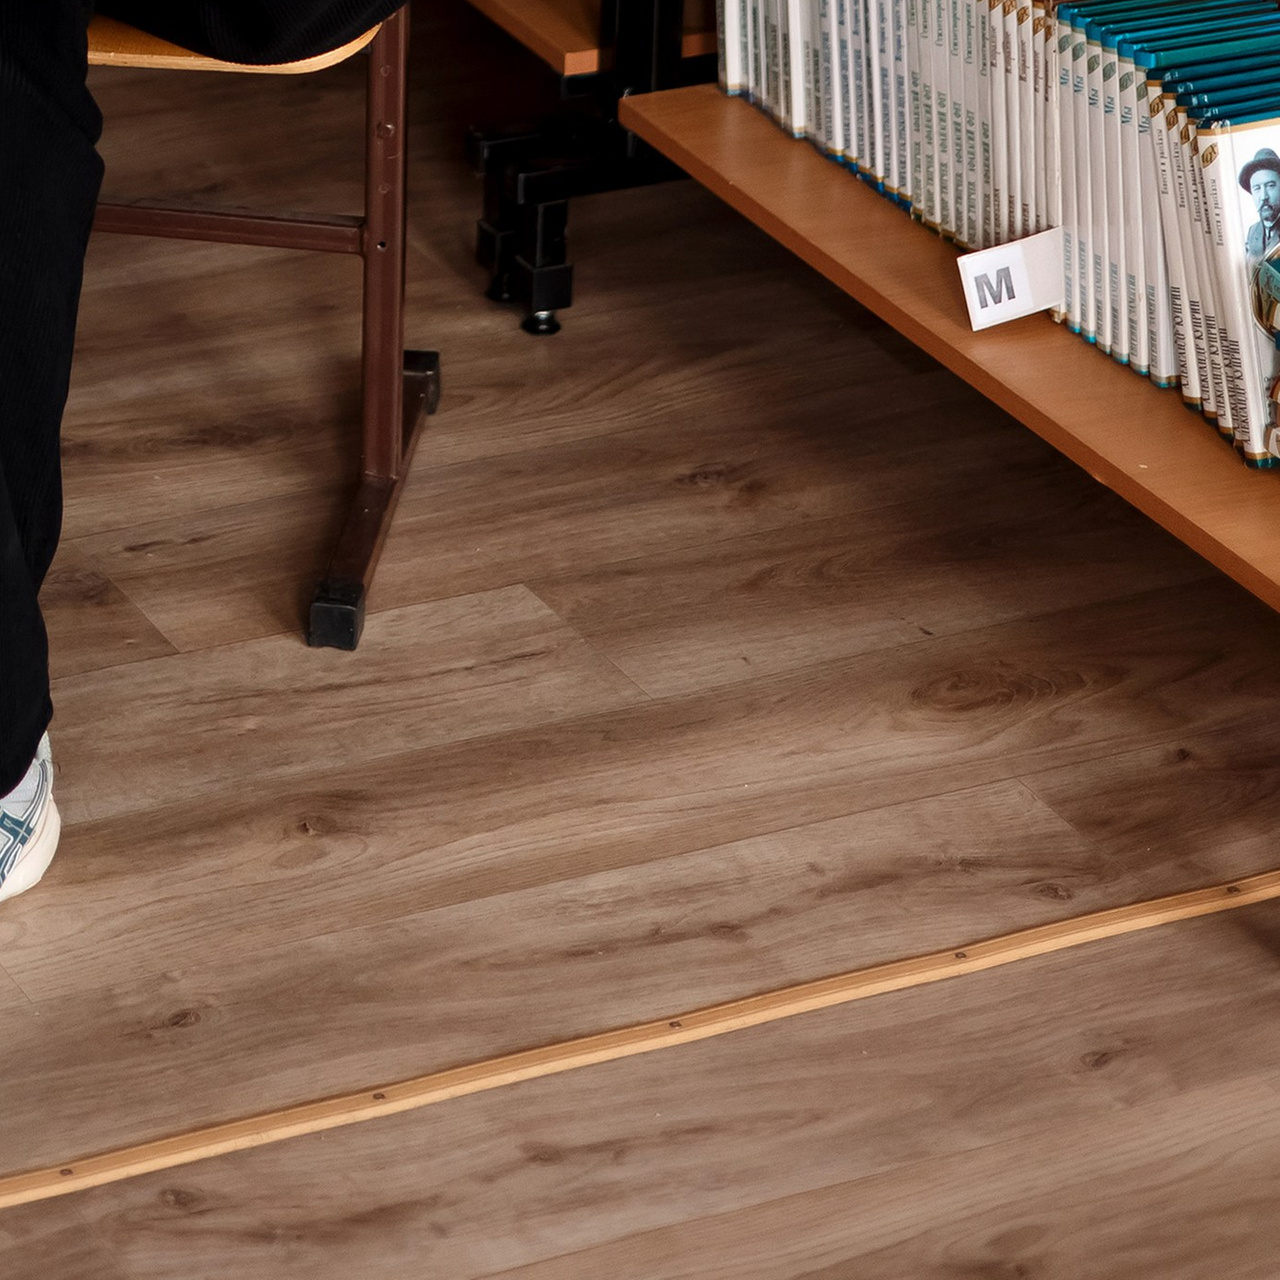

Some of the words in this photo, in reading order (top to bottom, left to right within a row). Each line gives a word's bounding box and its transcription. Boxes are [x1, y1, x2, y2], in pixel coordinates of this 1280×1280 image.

[1060, 67, 1069, 88] Мы
[1074, 74, 1085, 95] Мы
[1088, 87, 1099, 109] Мы
[1104, 96, 1115, 115] Мы
[1121, 105, 1132, 126] Мы
[1139, 115, 1150, 136] Мы
[974, 266, 1016, 309] М
[1170, 286, 1183, 327] КУПРИН
[1188, 300, 1204, 341] КУПРИН
[1204, 314, 1218, 356] КУПРИН
[1174, 329, 1190, 390] АЛЕКСАНДР
[1192, 342, 1211, 405] АЛЕКСАНДР
[1228, 339, 1243, 381] КУПРИН
[1208, 357, 1227, 421] АЛЕКСАНДР
[1231, 383, 1250, 446] АЛЕКСАНДР
